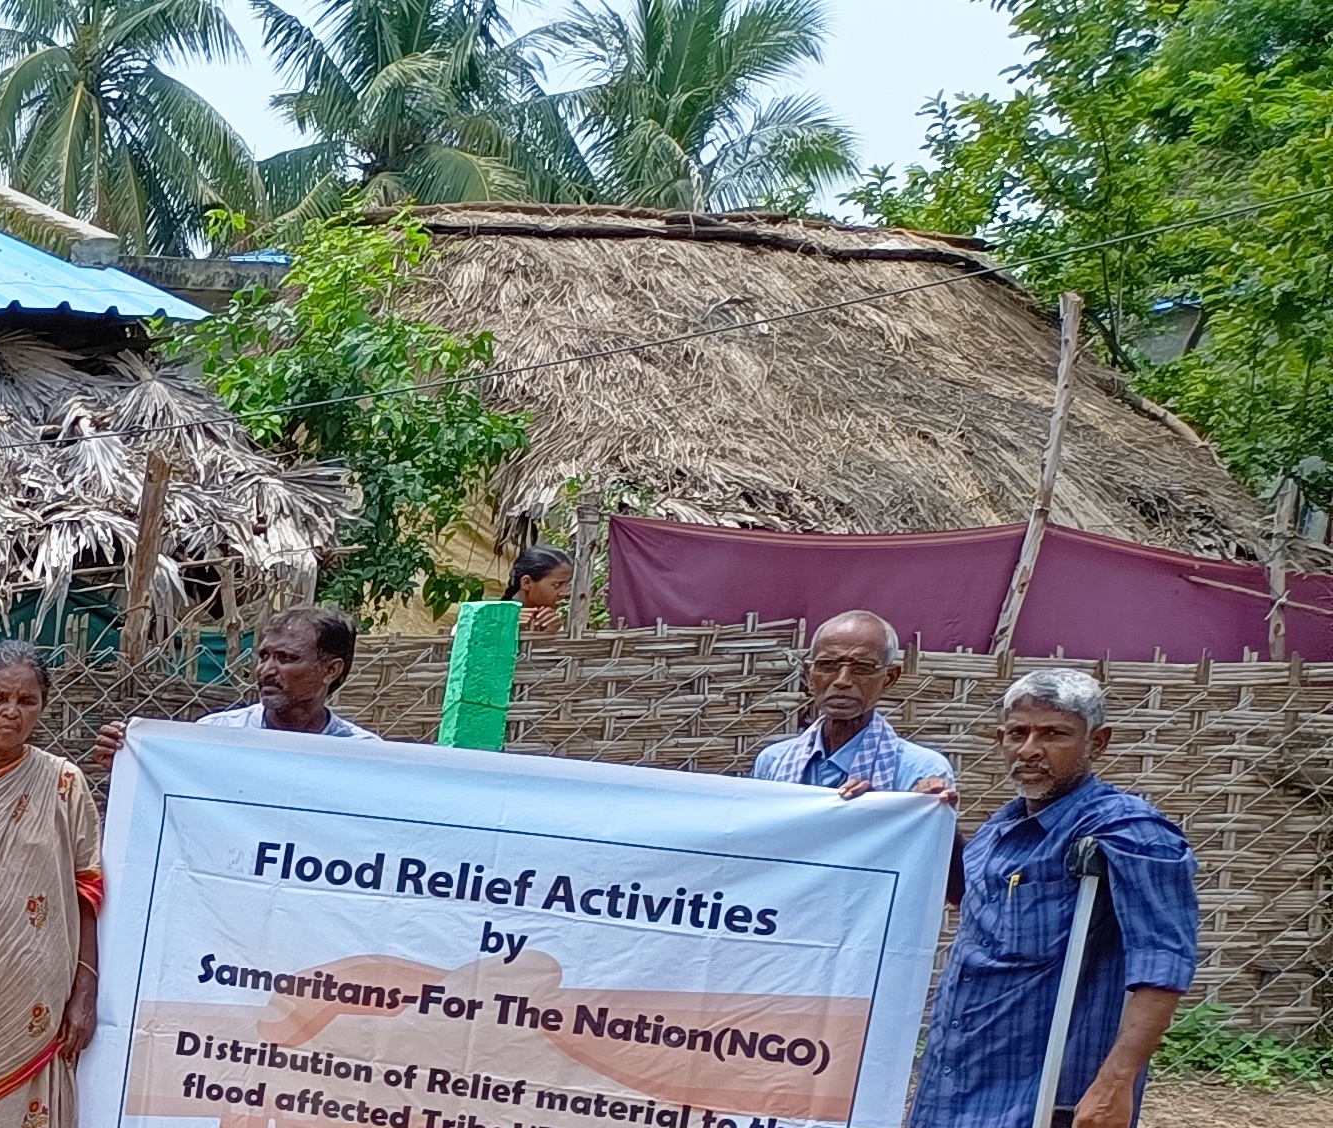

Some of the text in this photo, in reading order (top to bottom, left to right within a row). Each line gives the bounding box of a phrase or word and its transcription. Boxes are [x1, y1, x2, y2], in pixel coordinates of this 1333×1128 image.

[254, 841, 778, 936] Flood Relief Activities
[480, 921, 527, 964] by
[197, 953, 830, 1076] Samaritans-For The Nation(NGO)
[176, 1031, 372, 1083] Distribution
[383, 1065, 418, 1089] of
[426, 1068, 526, 1105] Relief
[182, 1072, 266, 1107] flood
